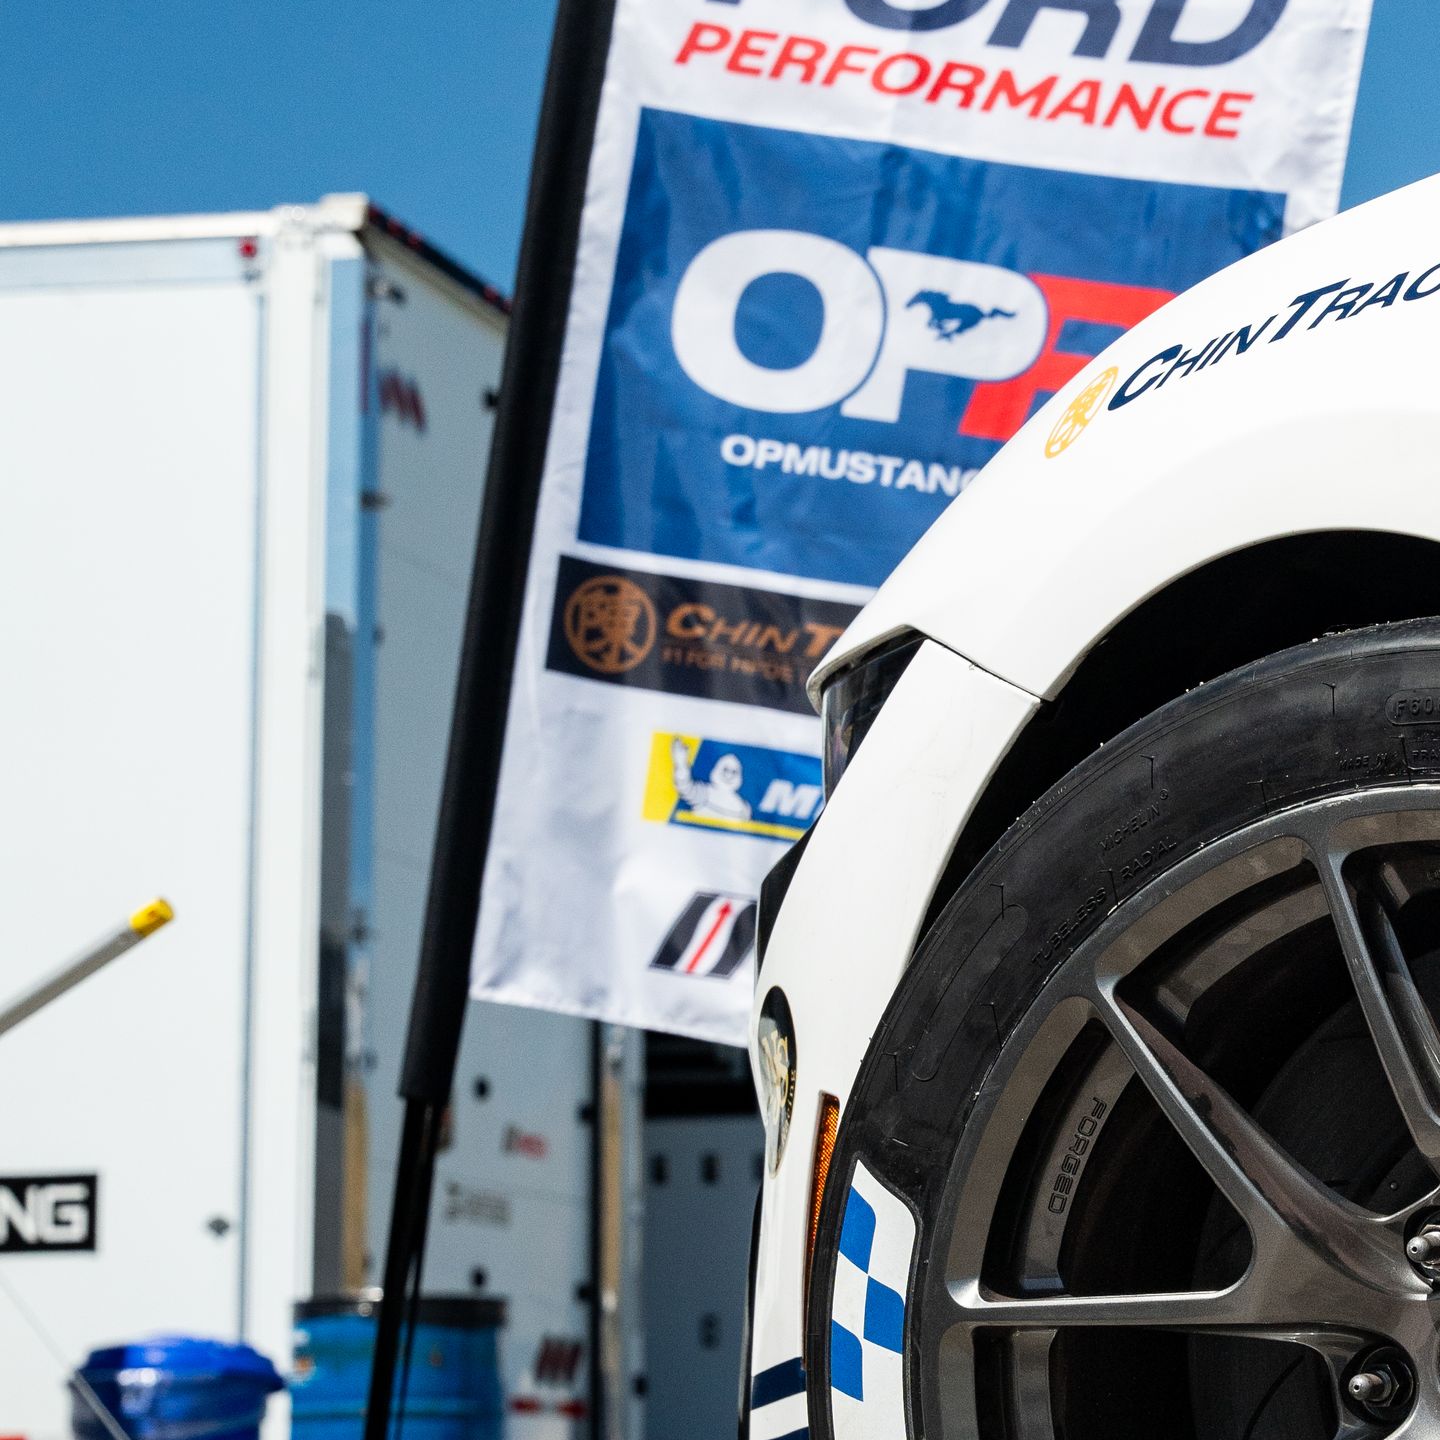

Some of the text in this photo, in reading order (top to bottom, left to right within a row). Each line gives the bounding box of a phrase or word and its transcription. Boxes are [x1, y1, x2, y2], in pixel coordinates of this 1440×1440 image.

[674, 23, 1255, 141] PERFORMANCE
[1119, 835, 1179, 881] RADIAL
[1046, 1096, 1108, 1215] FORGED
